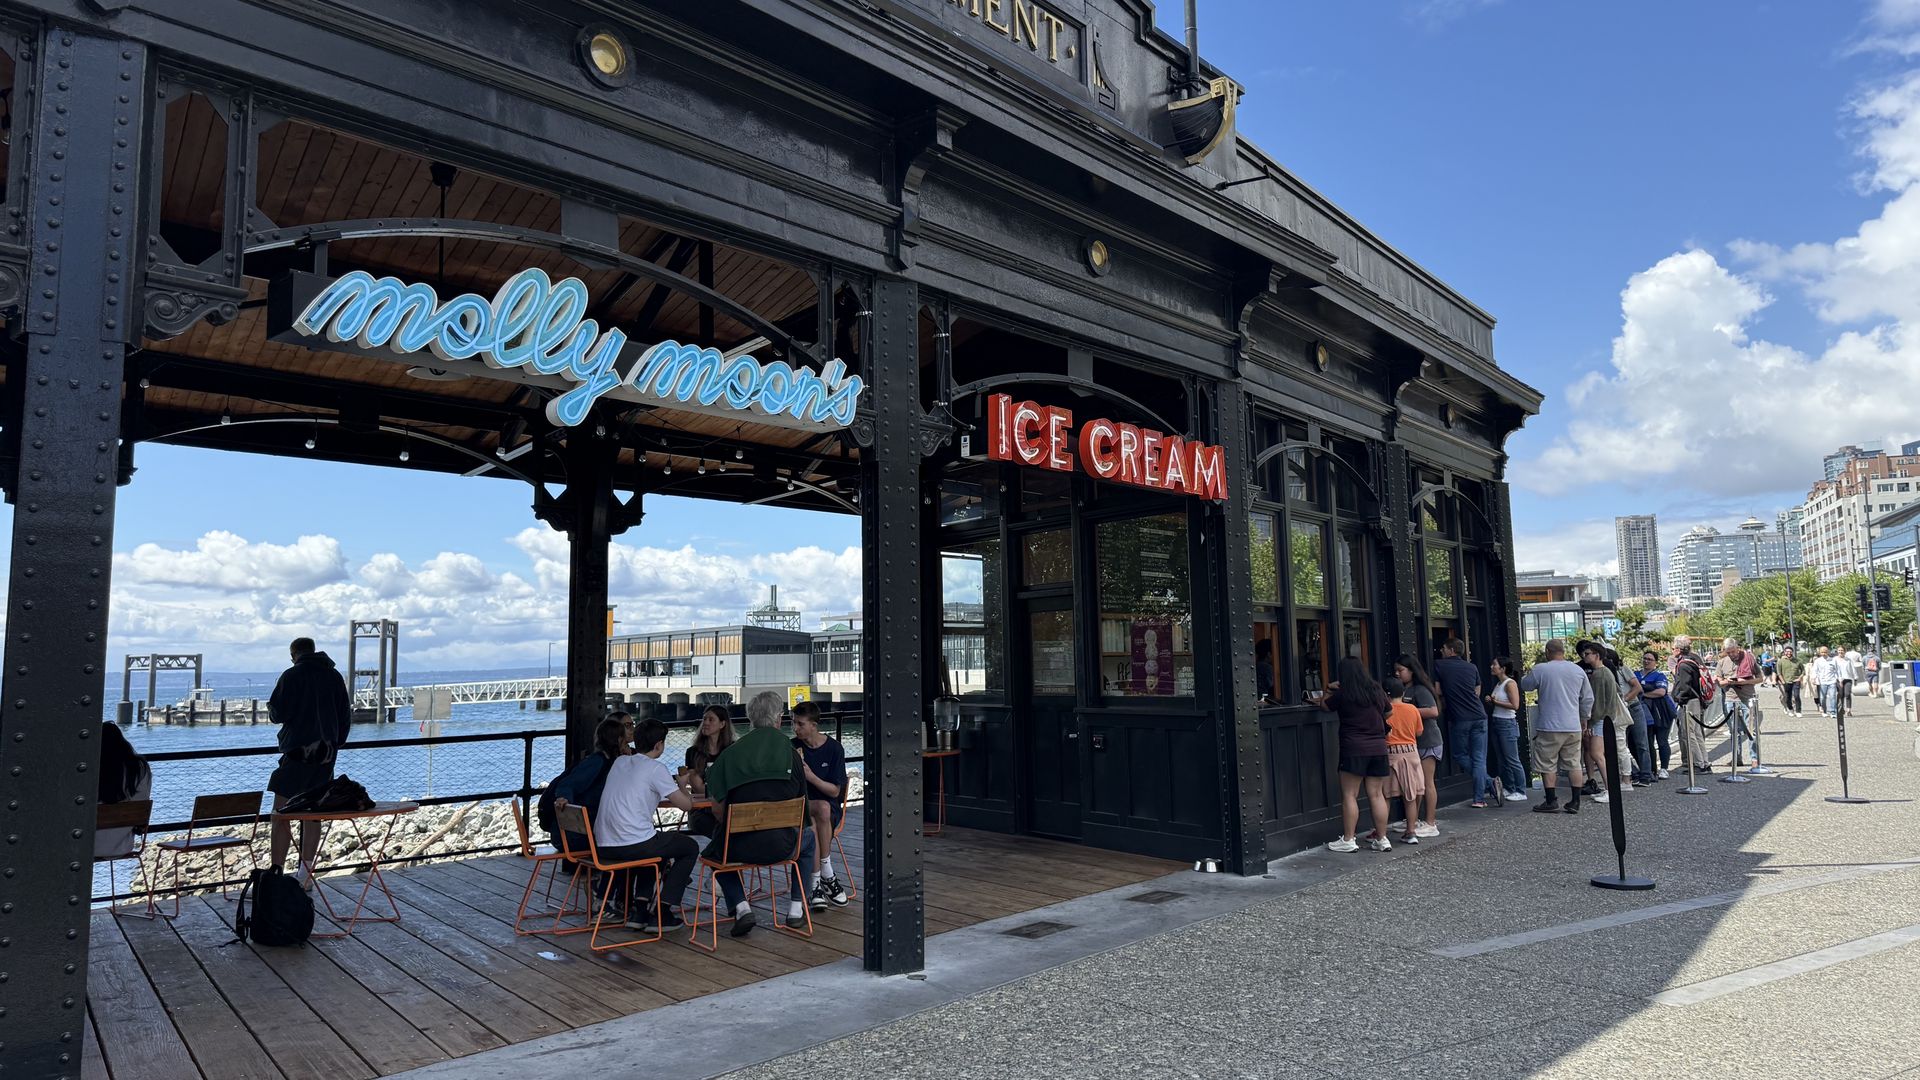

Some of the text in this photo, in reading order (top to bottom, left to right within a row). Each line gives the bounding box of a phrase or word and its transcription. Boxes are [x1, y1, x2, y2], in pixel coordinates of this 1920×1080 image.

[292, 268, 863, 427] molly moon's
[988, 393, 1228, 500] ICE CREAM
